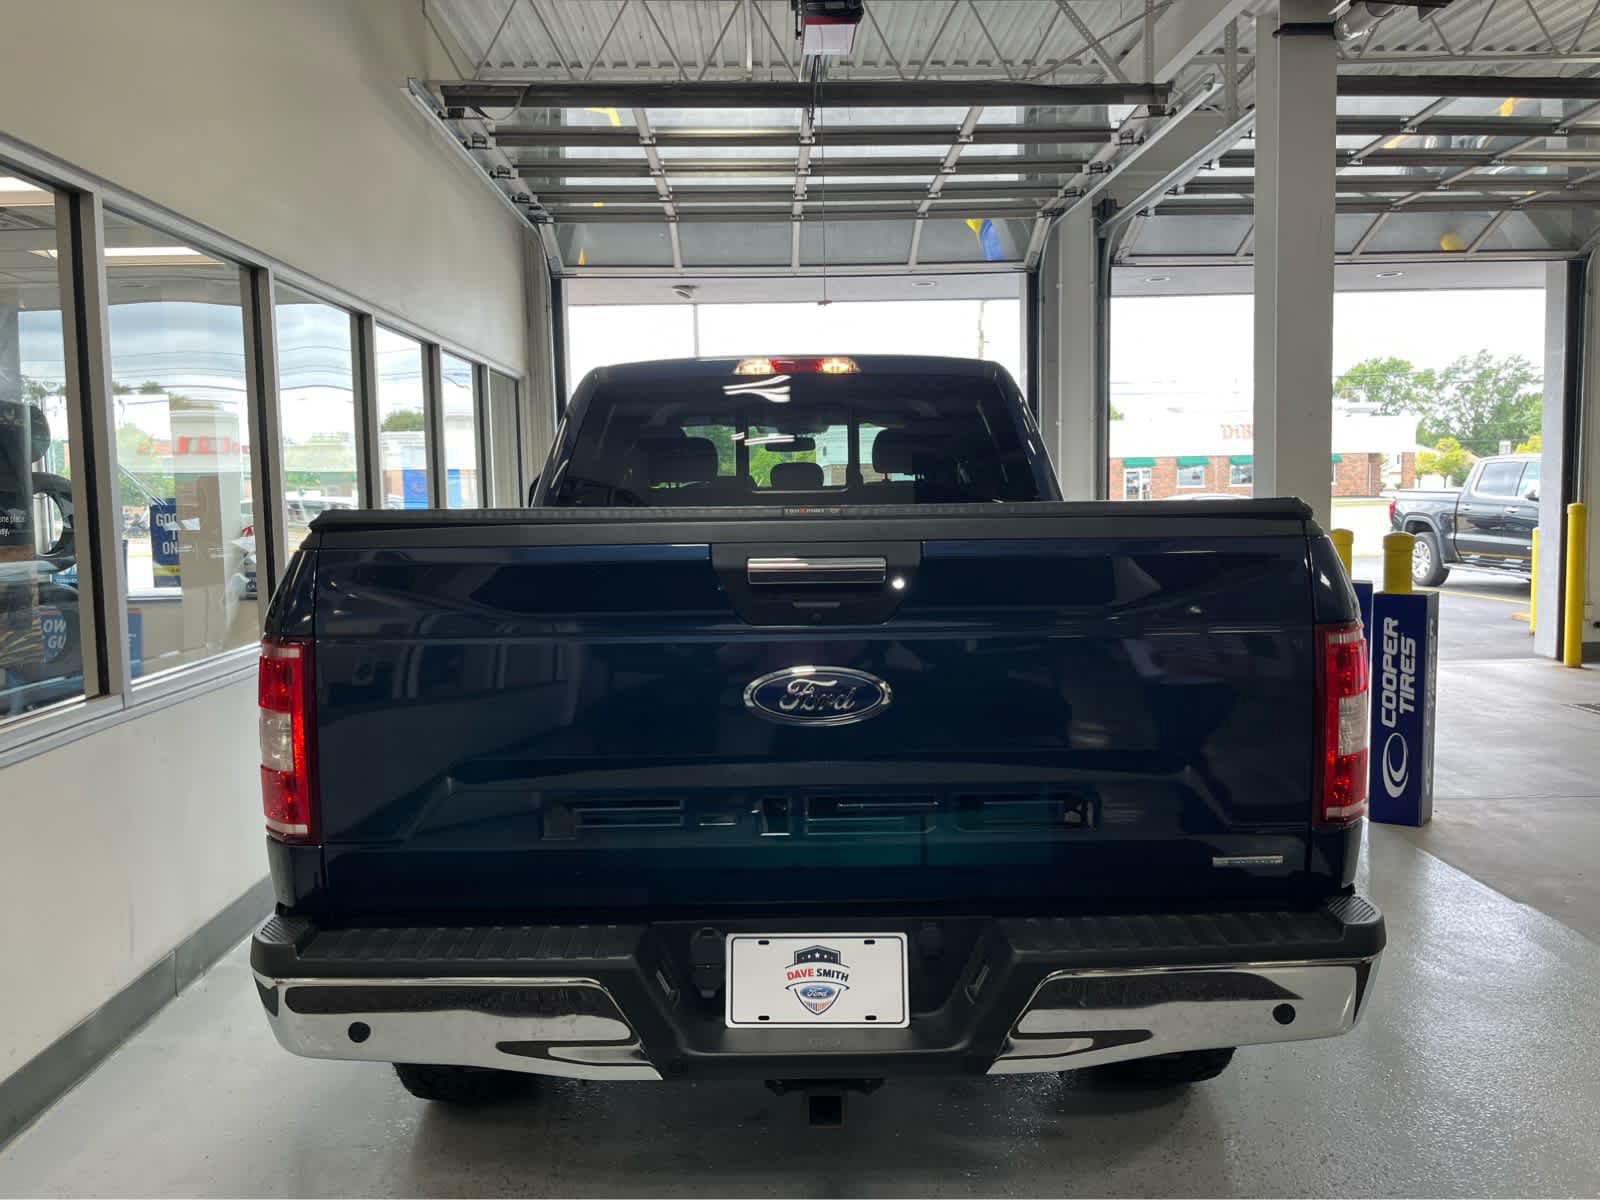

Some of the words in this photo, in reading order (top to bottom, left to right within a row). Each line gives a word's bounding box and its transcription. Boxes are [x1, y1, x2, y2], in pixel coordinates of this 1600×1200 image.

[779, 678, 856, 711] Ford
[1382, 617, 1399, 728] COOPER
[1399, 636, 1416, 714] TIRES
[540, 790, 1099, 840] F-150
[786, 968, 815, 981] DAVE
[816, 968, 849, 982] SMITH
